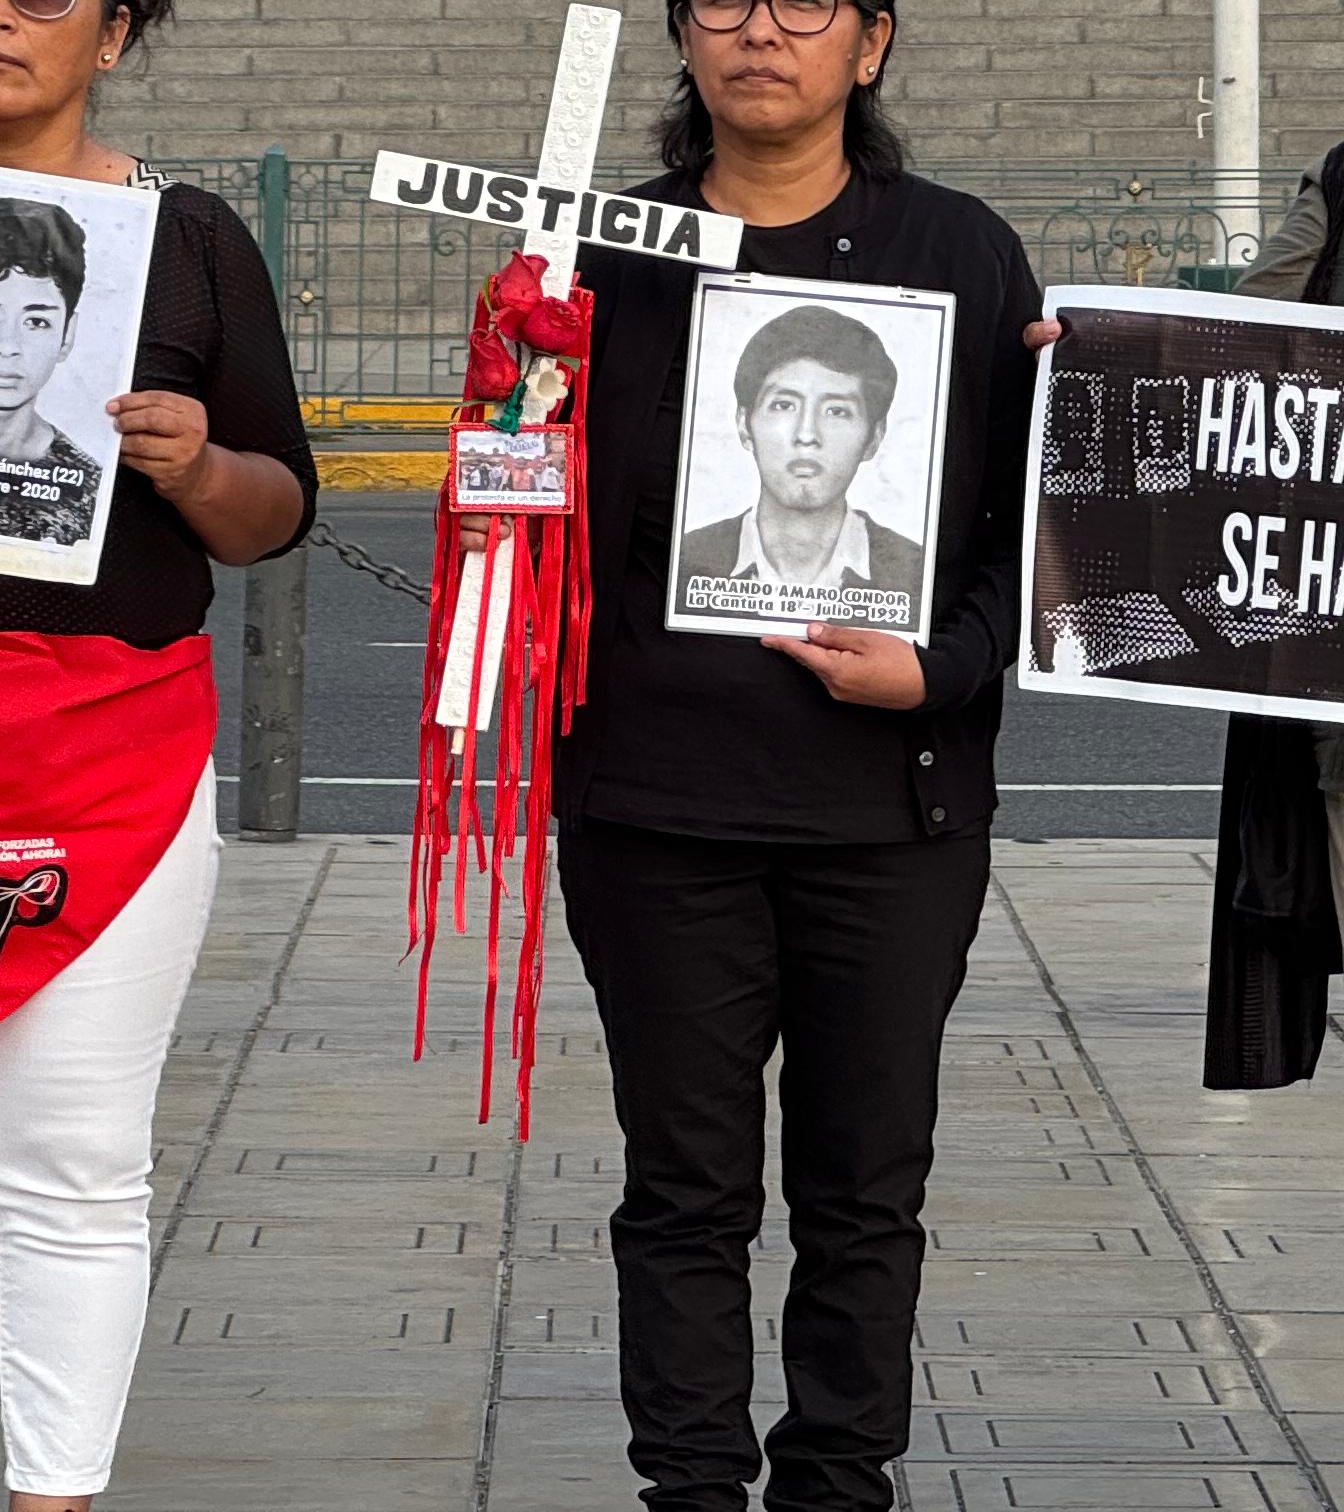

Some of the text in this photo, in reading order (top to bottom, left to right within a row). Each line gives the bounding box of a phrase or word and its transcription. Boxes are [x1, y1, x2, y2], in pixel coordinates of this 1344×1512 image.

[397, 162, 701, 259] JUSTICIA
[52, 465, 85, 487] (22)
[20, 482, 61, 502] 2020
[1216, 511, 1288, 610] SE
[689, 578, 908, 606] ARMANDO AMARO CONDOR
[688, 592, 705, 606] La
[711, 595, 774, 612] Cantuta
[816, 603, 851, 617] Julio
[870, 608, 908, 622] 1992
